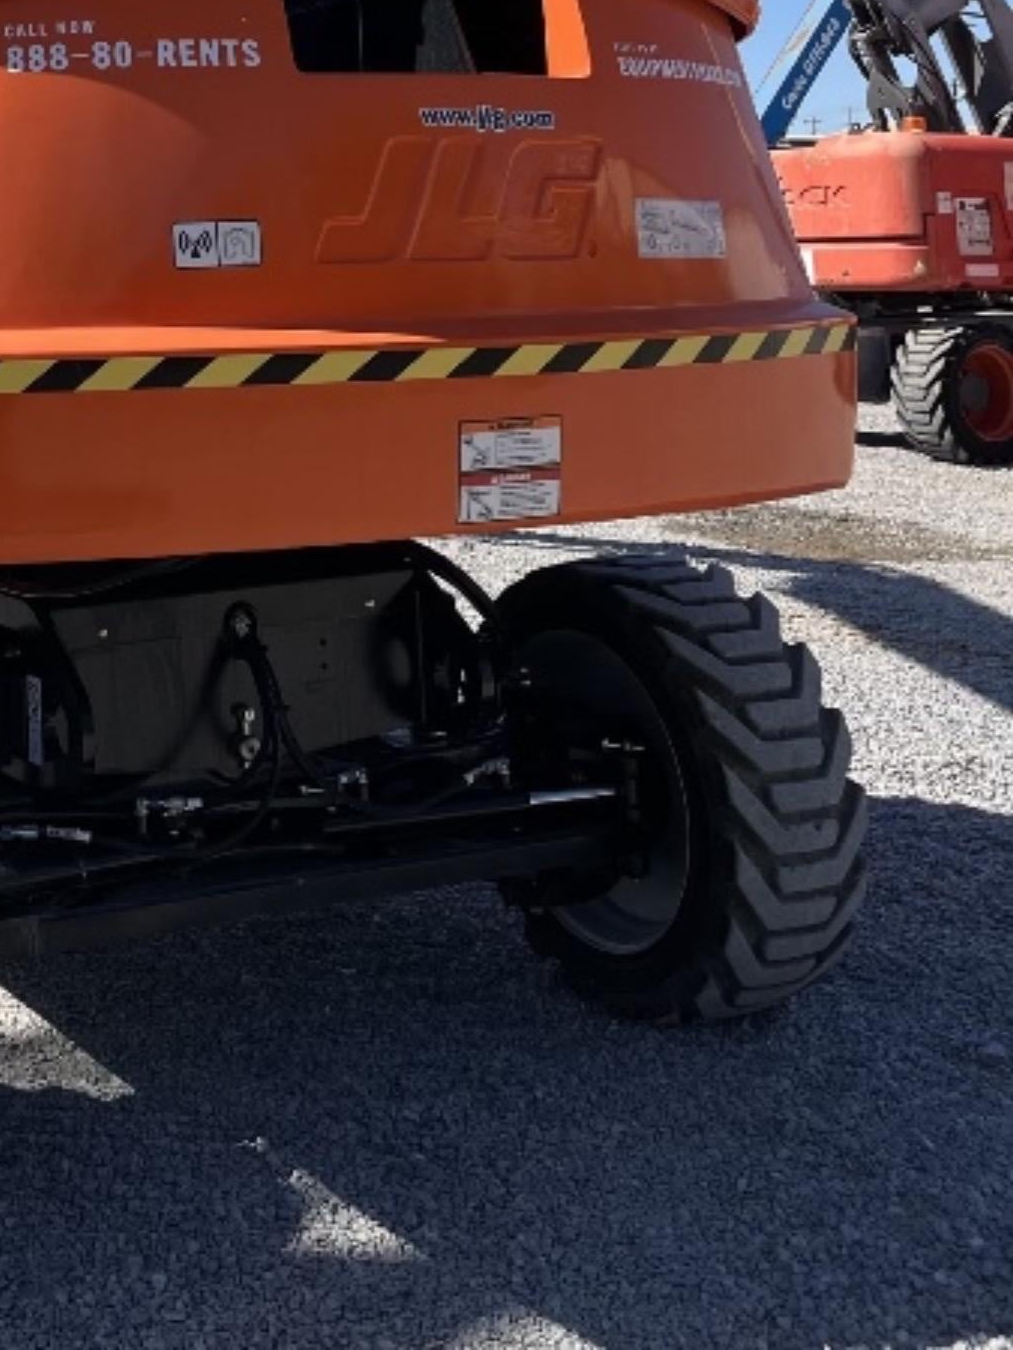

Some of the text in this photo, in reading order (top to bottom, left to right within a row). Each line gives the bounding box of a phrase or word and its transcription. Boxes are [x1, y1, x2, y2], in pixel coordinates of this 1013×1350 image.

[6, 38, 262, 74] 888-80-RENTS
[419, 104, 555, 132] www.jlg.com
[315, 134, 603, 264] JLG
